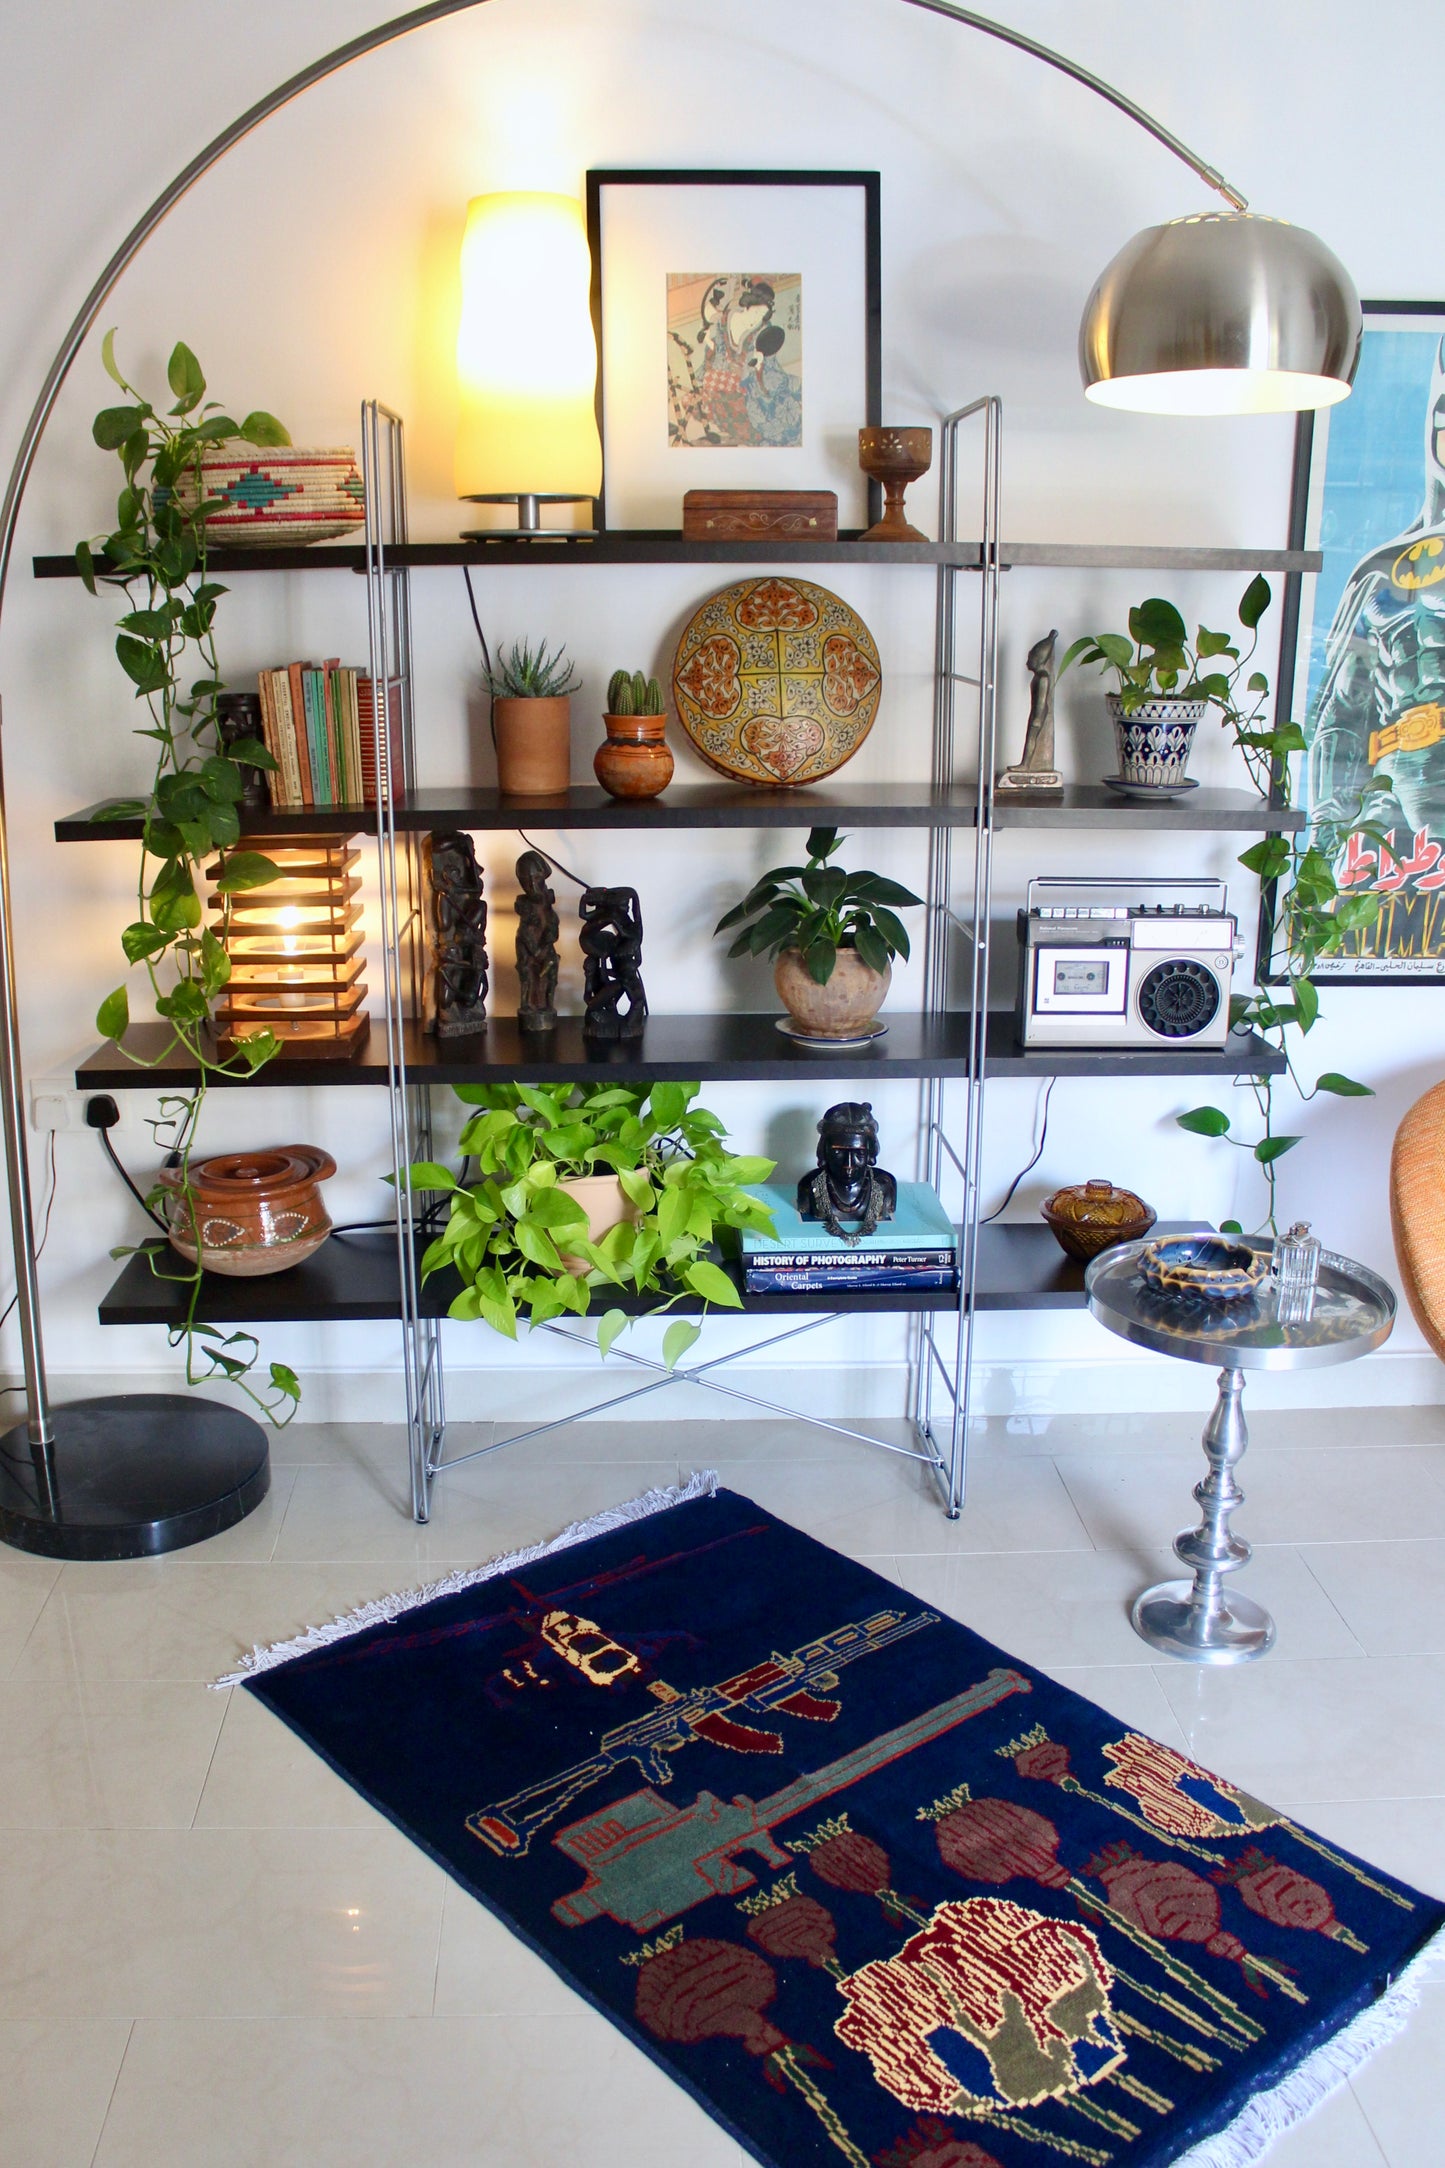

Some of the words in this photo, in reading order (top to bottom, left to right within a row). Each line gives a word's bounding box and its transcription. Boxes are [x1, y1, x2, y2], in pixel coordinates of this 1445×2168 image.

[753, 1238, 796, 1250] DESERT
[753, 1256, 795, 1266] HISTORY
[796, 1256, 809, 1265] OF
[811, 1254, 886, 1265] PHOTOGRAPHY
[775, 1273, 808, 1281] Oriental
[791, 1282, 823, 1290] Carpets
